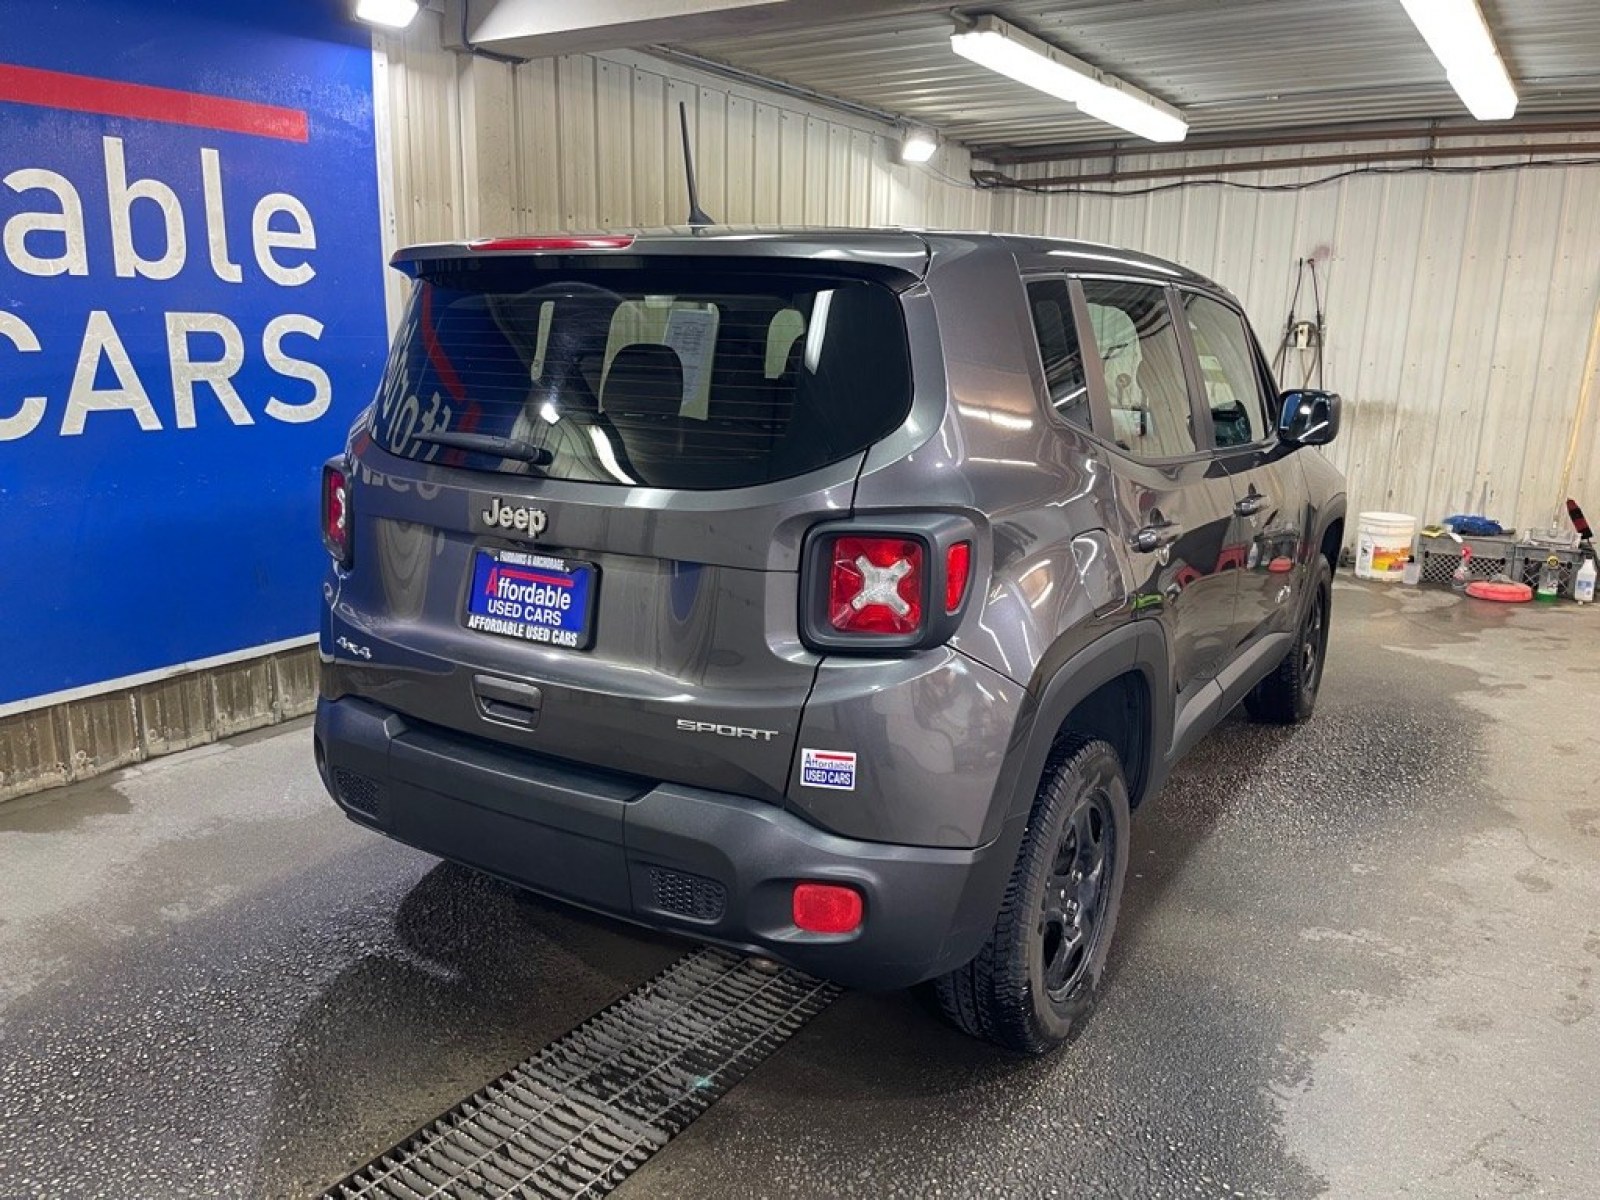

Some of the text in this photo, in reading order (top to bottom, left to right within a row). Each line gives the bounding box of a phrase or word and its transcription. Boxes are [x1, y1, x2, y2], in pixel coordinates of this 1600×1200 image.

[2, 136, 316, 287] able
[0, 310, 332, 441] CARS
[482, 498, 548, 539] Jeep
[485, 567, 571, 610] Affordable
[468, 615, 578, 648] AFFORDABLE USED CARS
[488, 599, 562, 627] USED CARS
[676, 718, 779, 741] SPORT
[805, 769, 851, 785] USED CARS
